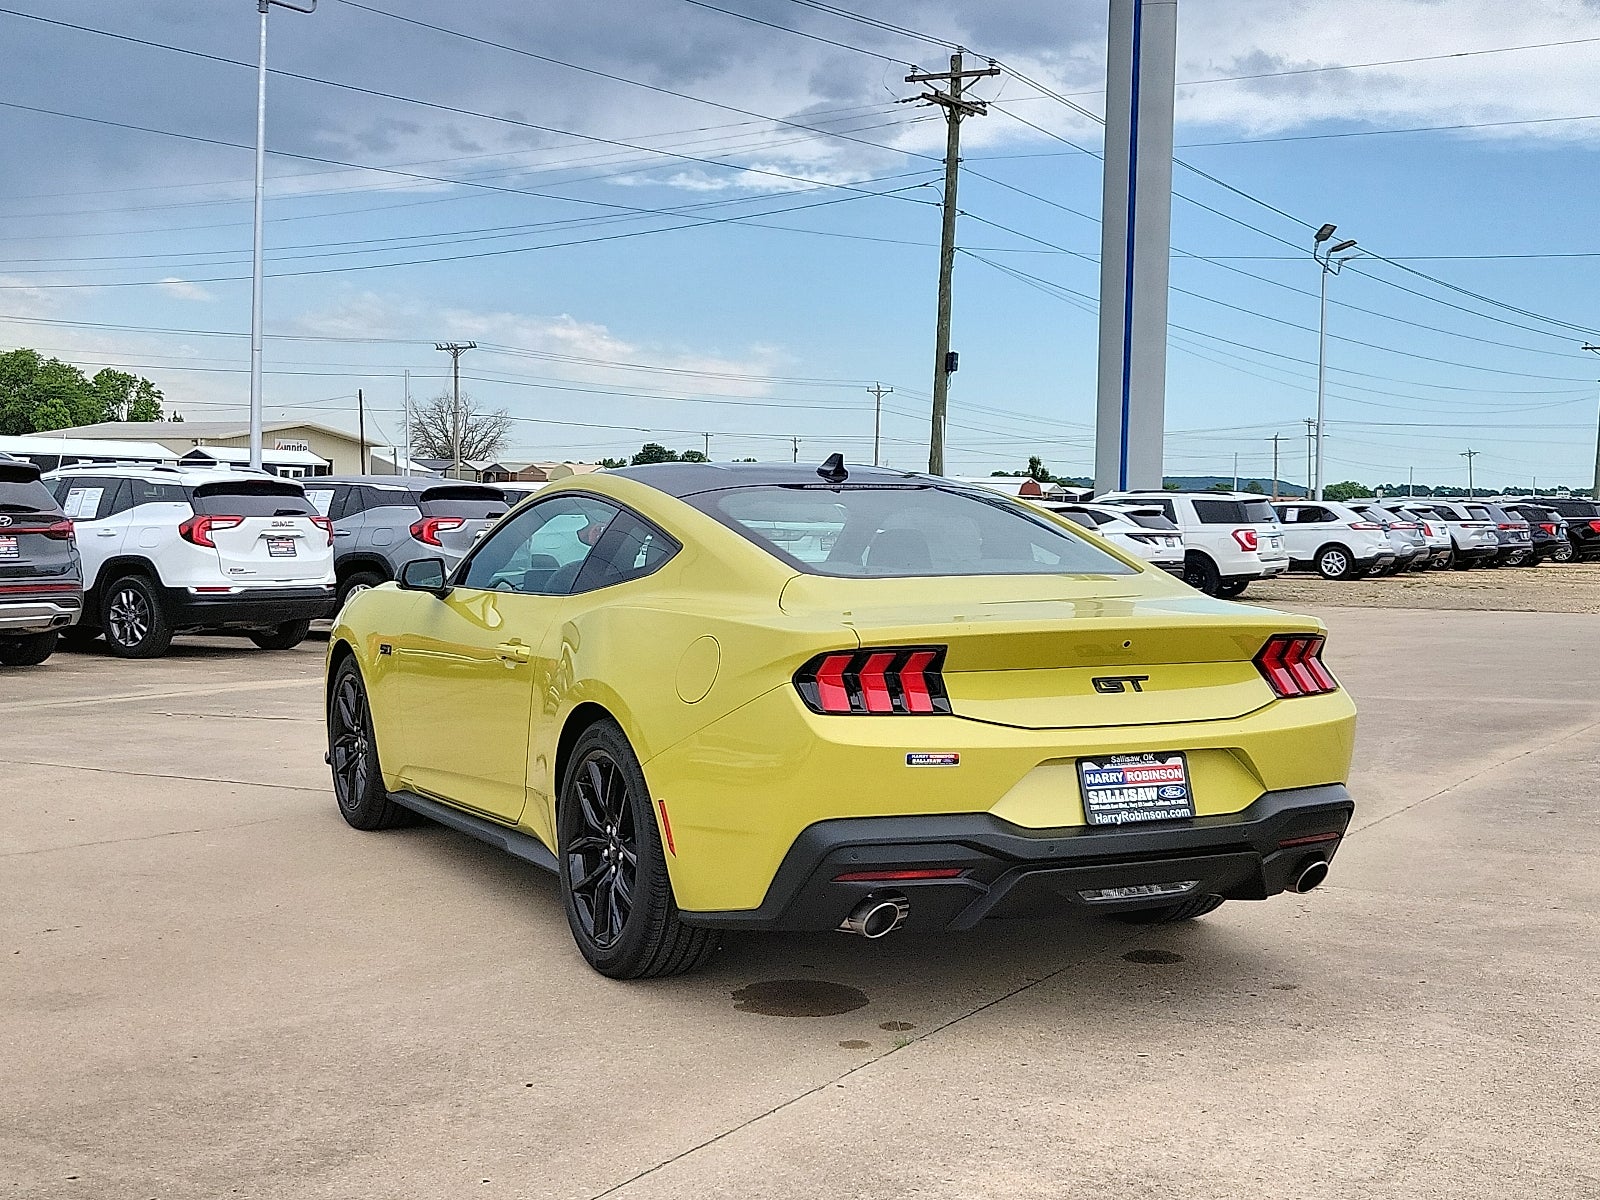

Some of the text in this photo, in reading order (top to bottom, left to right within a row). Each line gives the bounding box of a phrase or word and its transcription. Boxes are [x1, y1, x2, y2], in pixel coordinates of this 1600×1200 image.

[1091, 675, 1149, 693] GT
[1142, 753, 1155, 761] OK
[1085, 768, 1183, 785] HARRY ROBINSON
[1087, 787, 1158, 804] SALLISAW
[1094, 808, 1191, 825] HarryRobinson.com
